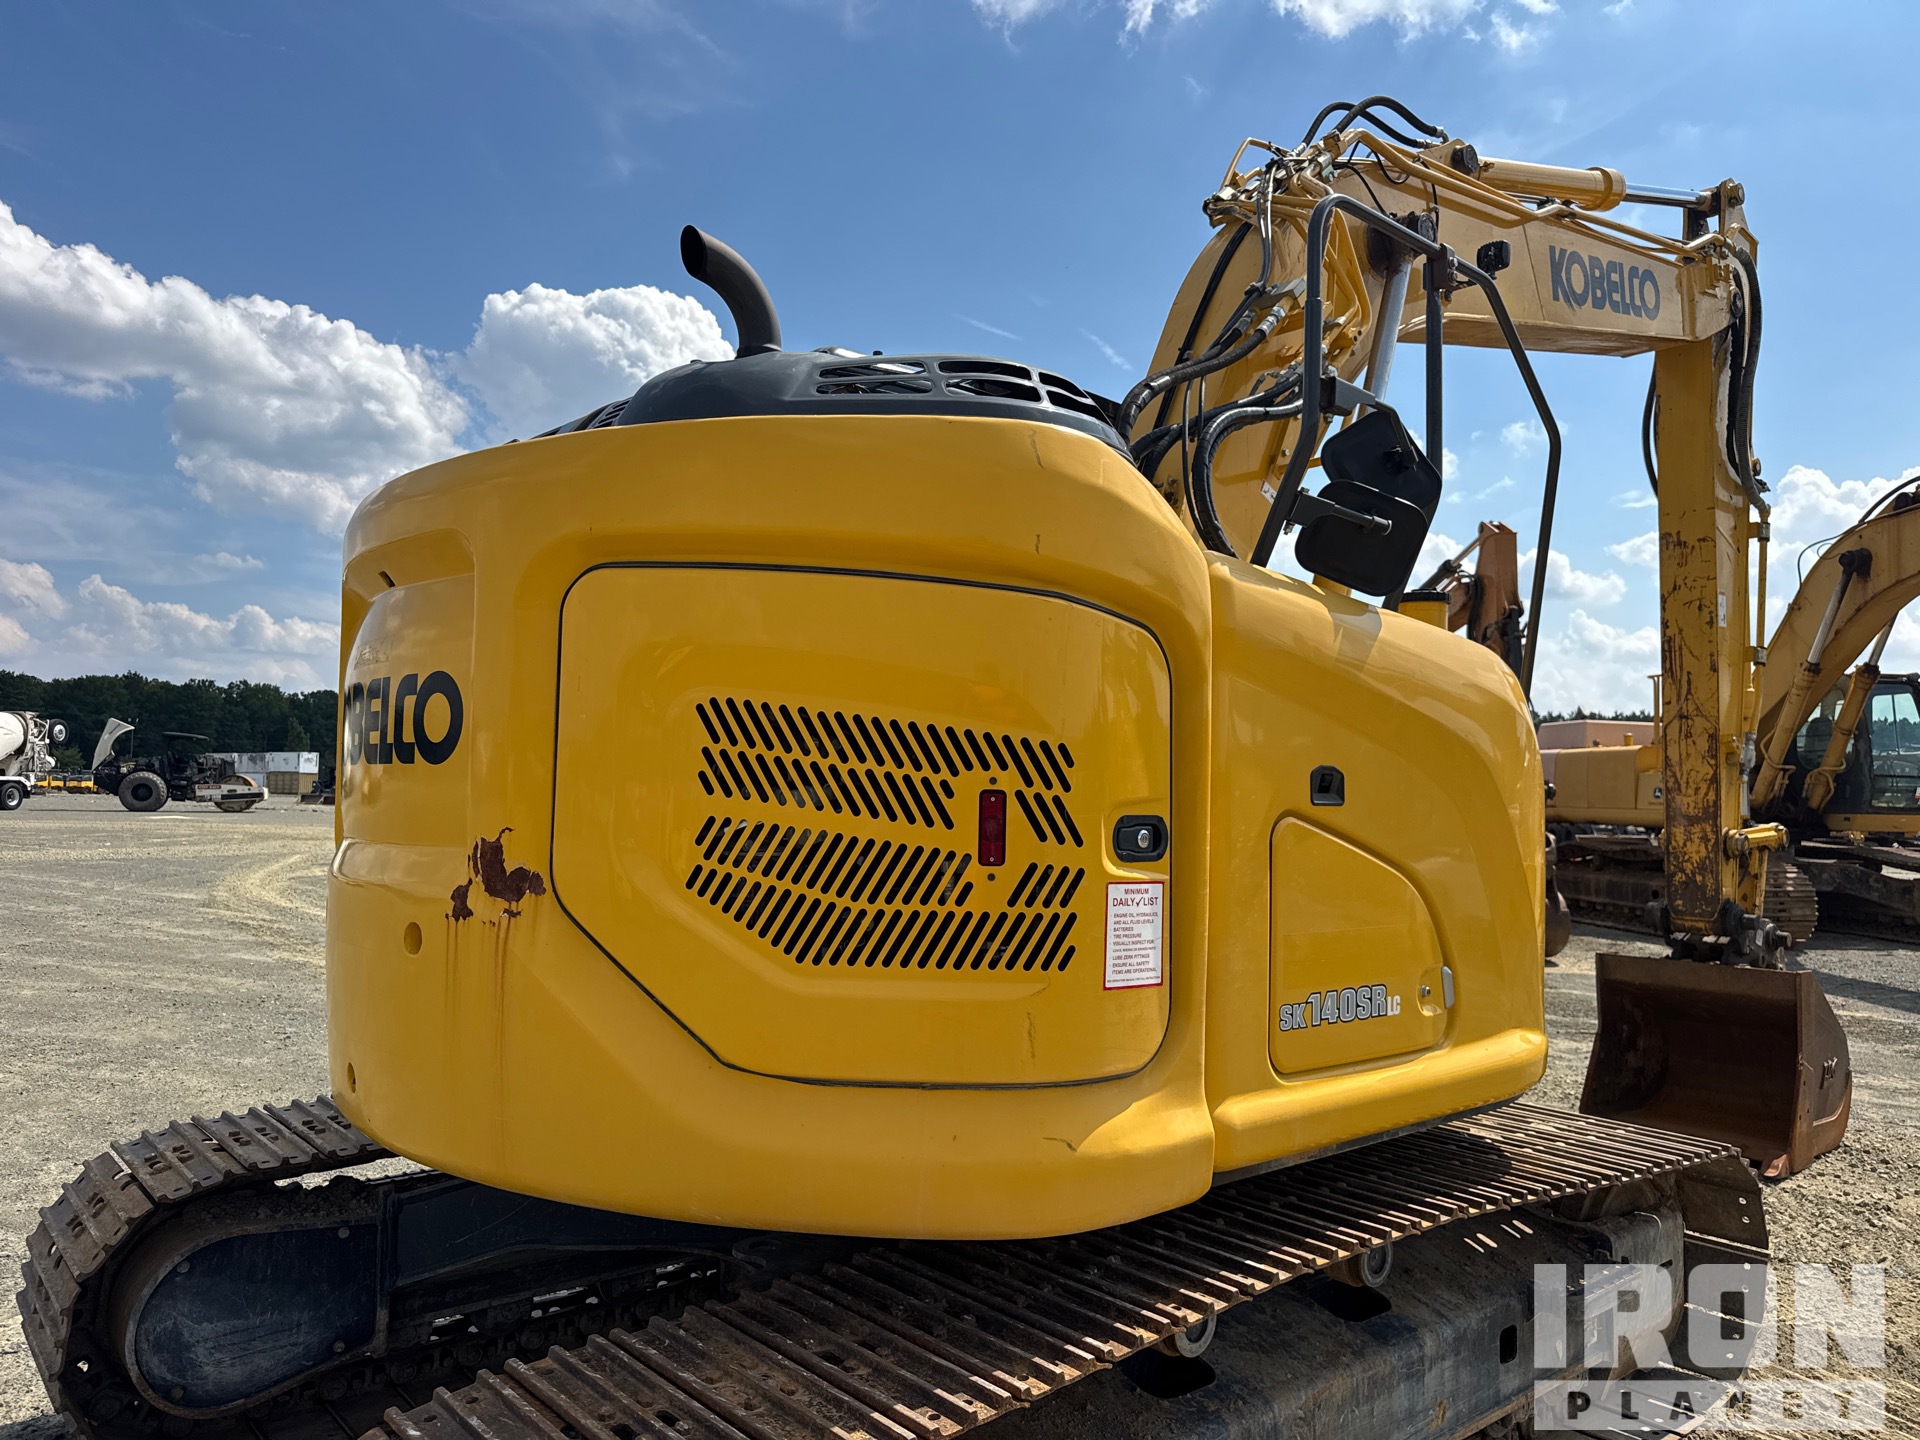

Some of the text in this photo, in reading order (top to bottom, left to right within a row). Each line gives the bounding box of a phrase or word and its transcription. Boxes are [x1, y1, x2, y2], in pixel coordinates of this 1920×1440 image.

[1549, 245, 1660, 321] KOBELCO
[1112, 896, 1158, 907] DAILY LIST
